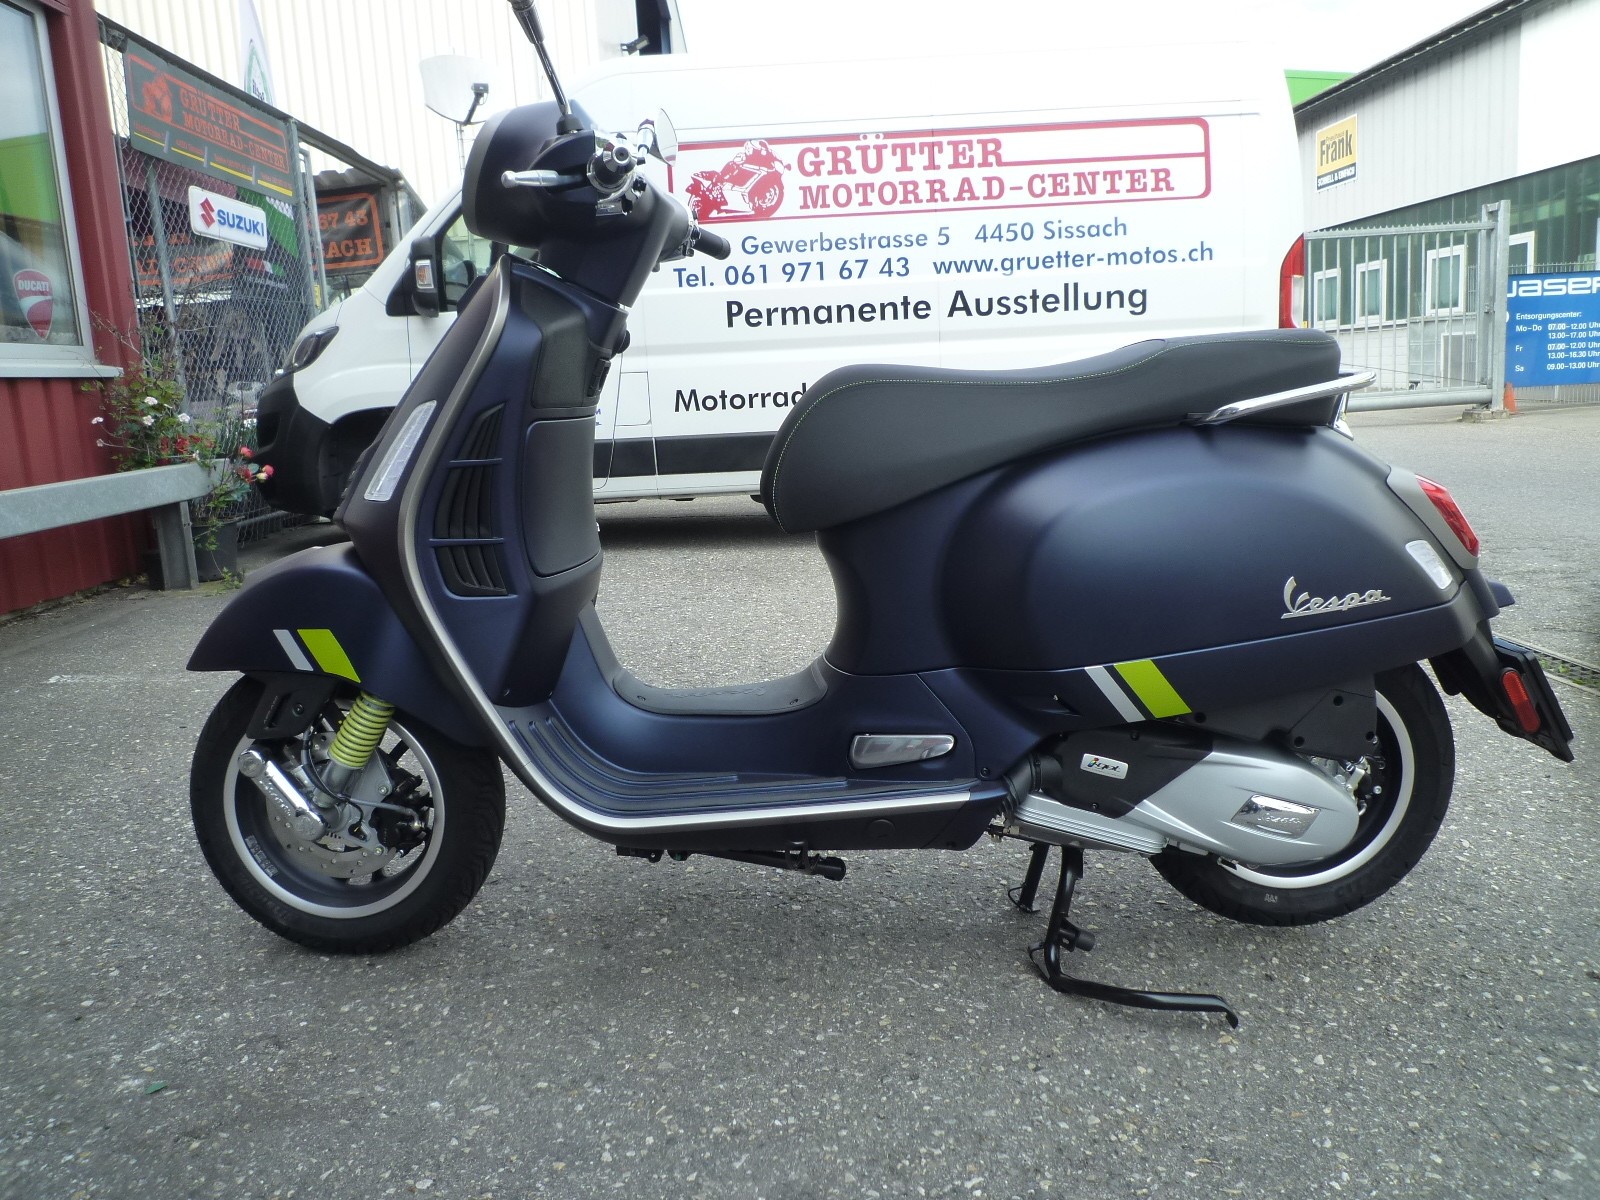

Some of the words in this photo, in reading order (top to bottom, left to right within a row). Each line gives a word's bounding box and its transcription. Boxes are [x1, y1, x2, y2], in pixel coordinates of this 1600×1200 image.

[797, 133, 1003, 177] GRÜTTER
[1320, 129, 1353, 166] Frank
[799, 168, 1175, 210] MOTORRAD-CENTER
[217, 209, 265, 237] SUZUKI
[741, 232, 928, 255] Gewerbestrasse
[937, 226, 950, 246] 5
[975, 222, 1034, 243] 4450
[1043, 217, 1128, 240] Sissach
[673, 266, 715, 288] Tel.
[724, 264, 768, 286] 061
[782, 261, 825, 283] 971
[839, 259, 869, 279] 67
[879, 257, 910, 277] 43
[933, 241, 1213, 276] www.gruetter-motos.ch
[18, 279, 50, 292] DUCATI
[726, 296, 931, 328] Permanente
[947, 282, 1147, 317] Ausstellung
[1515, 311, 1582, 321] Entsorgungscenter:
[1515, 364, 1525, 372] Sa
[1281, 575, 1391, 619] Vespa
